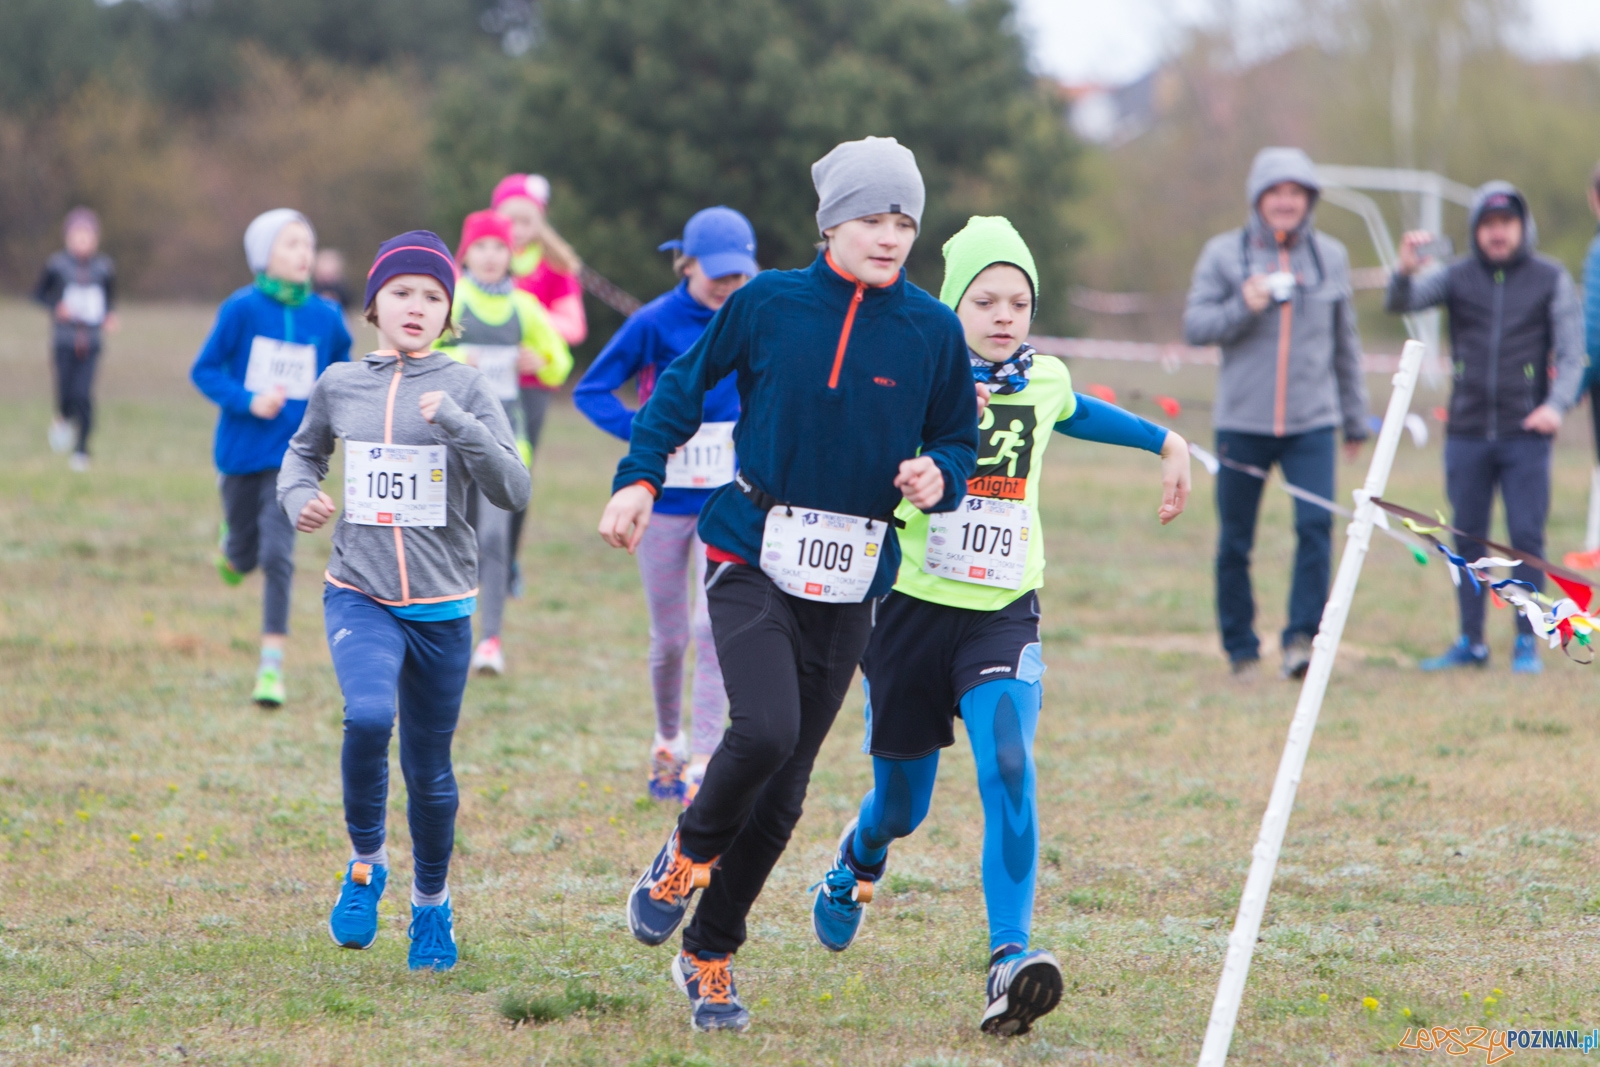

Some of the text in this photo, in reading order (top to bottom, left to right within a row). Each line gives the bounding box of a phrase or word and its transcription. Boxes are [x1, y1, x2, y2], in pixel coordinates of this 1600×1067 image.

[683, 445, 721, 466] 1117
[367, 471, 417, 500] 1051
[973, 476, 1019, 496] night
[962, 522, 1012, 557] 1079
[798, 537, 853, 573] 1009
